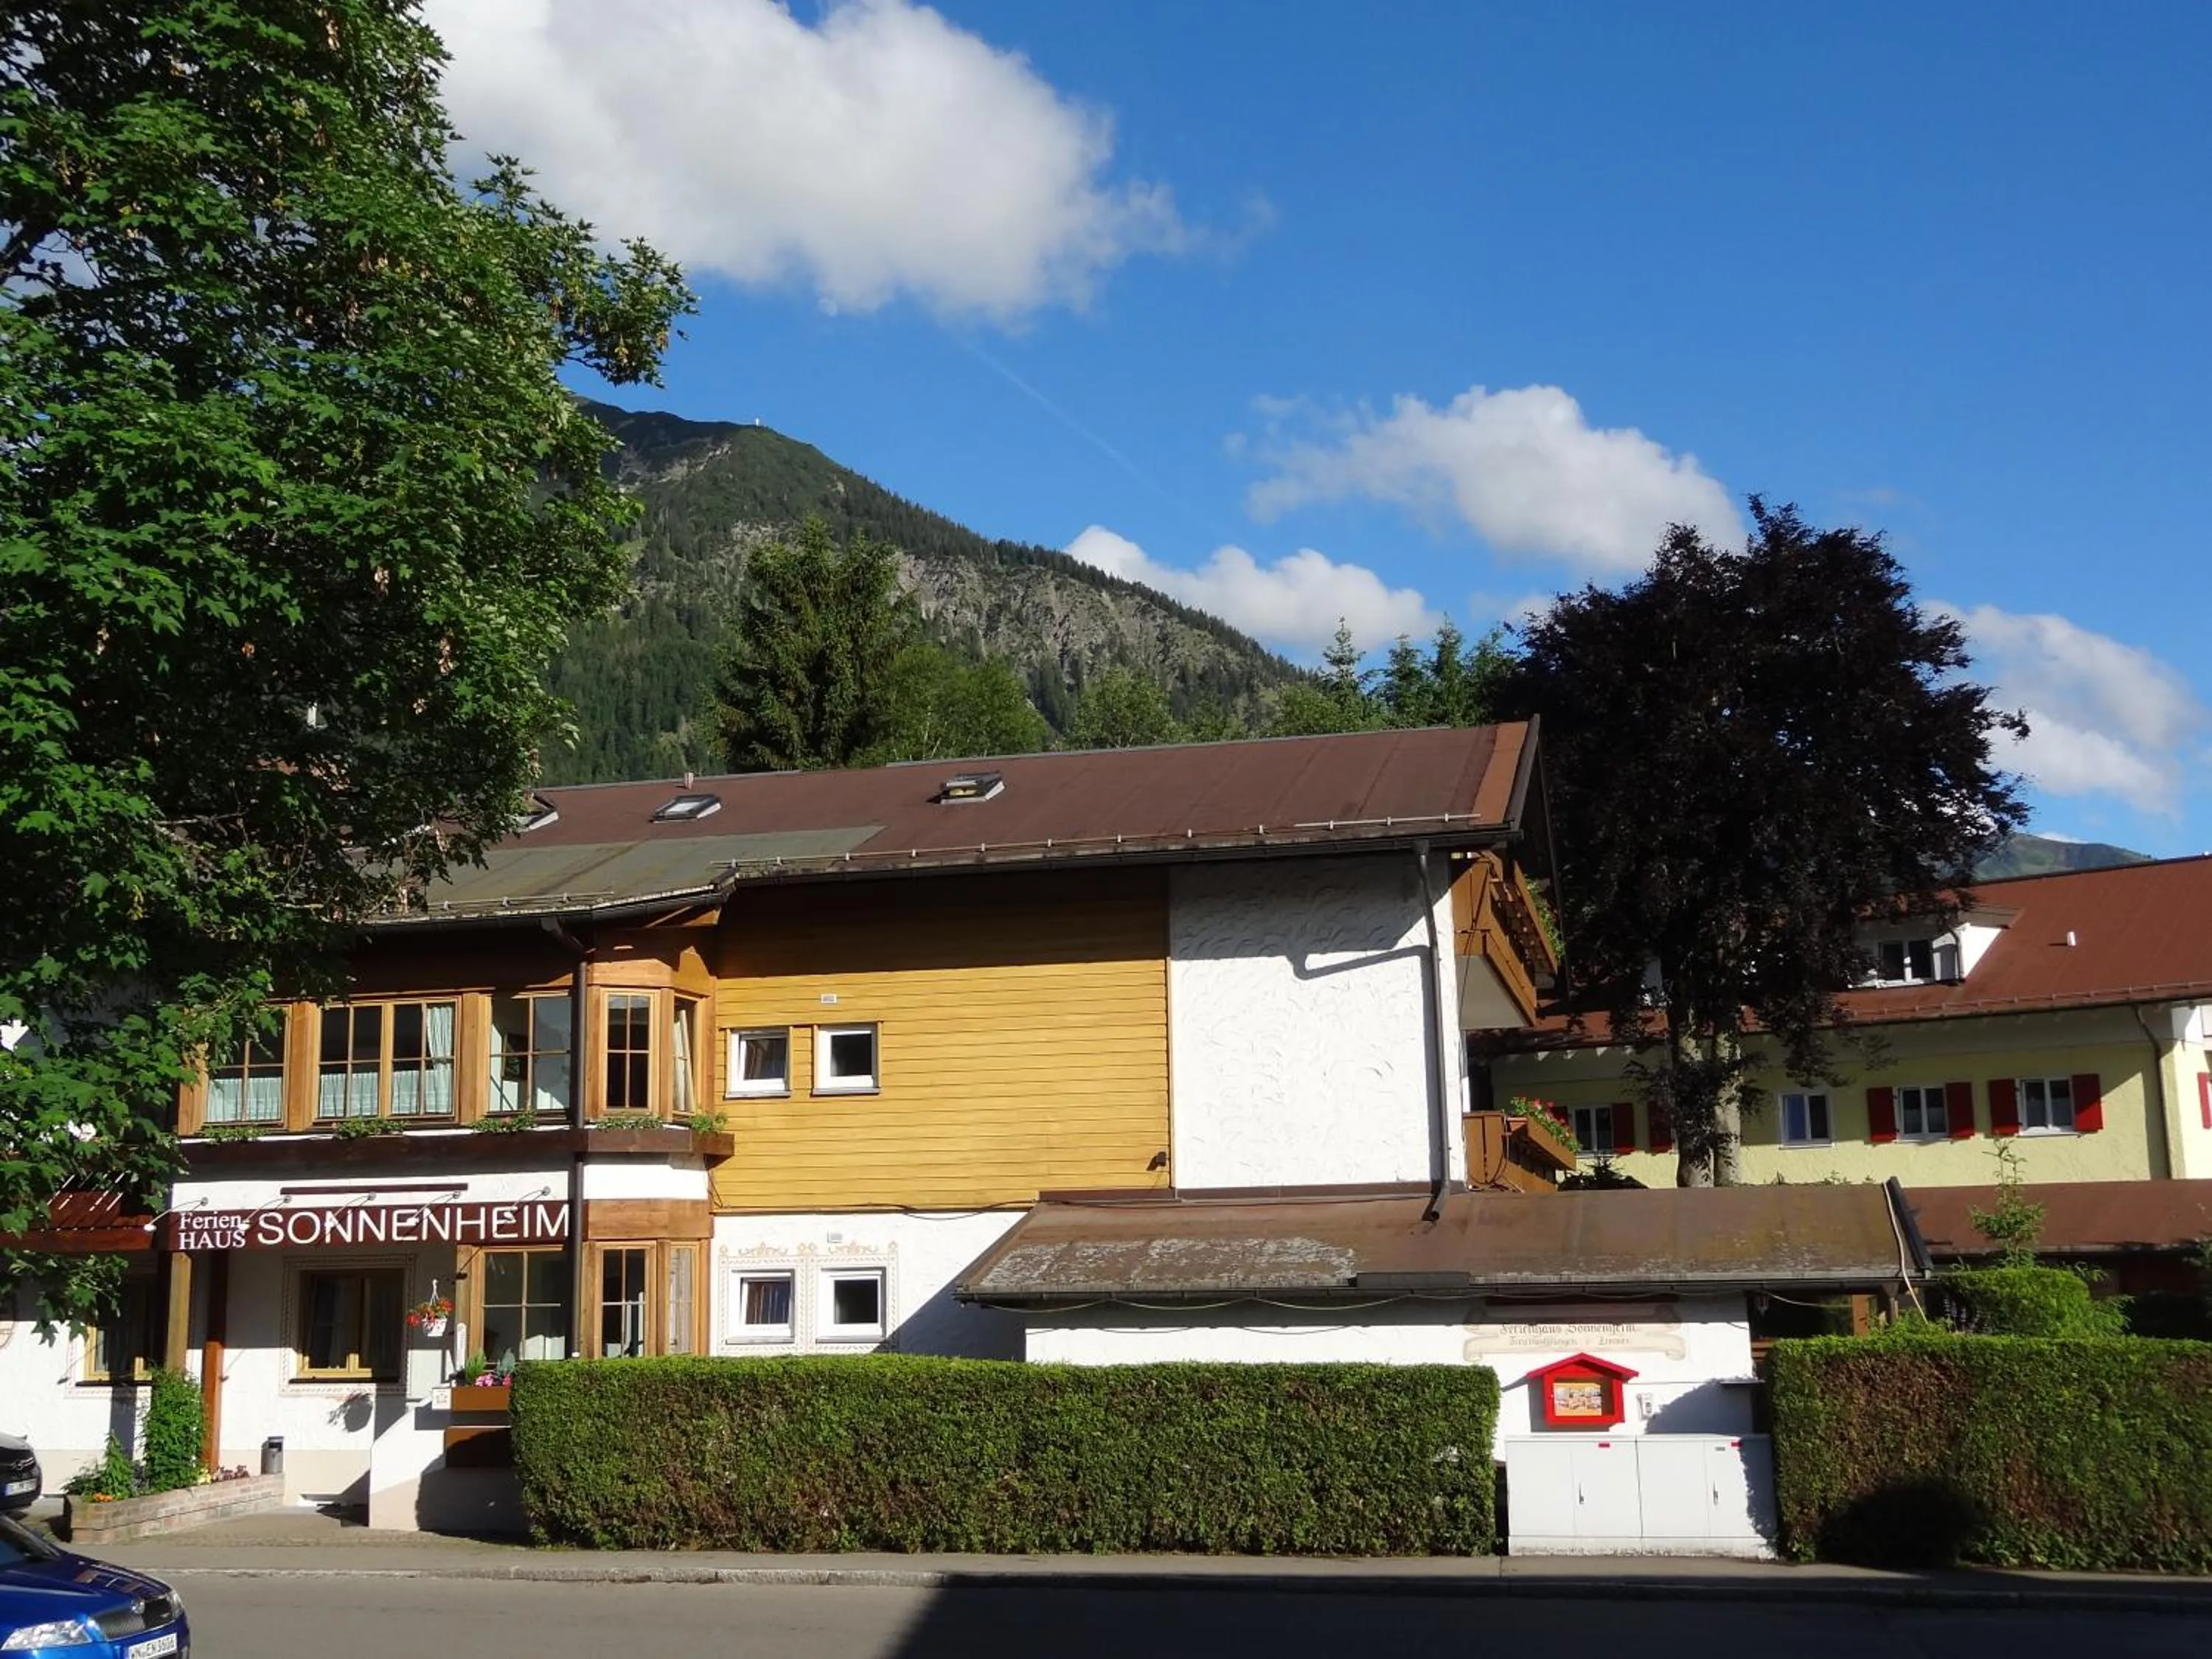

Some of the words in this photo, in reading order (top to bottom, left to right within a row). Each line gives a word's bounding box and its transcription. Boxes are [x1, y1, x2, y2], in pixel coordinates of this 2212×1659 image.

[179, 1210, 243, 1230] Ferien
[257, 1204, 570, 1245] SONNENHEIM
[178, 1229, 246, 1250] HAUS
